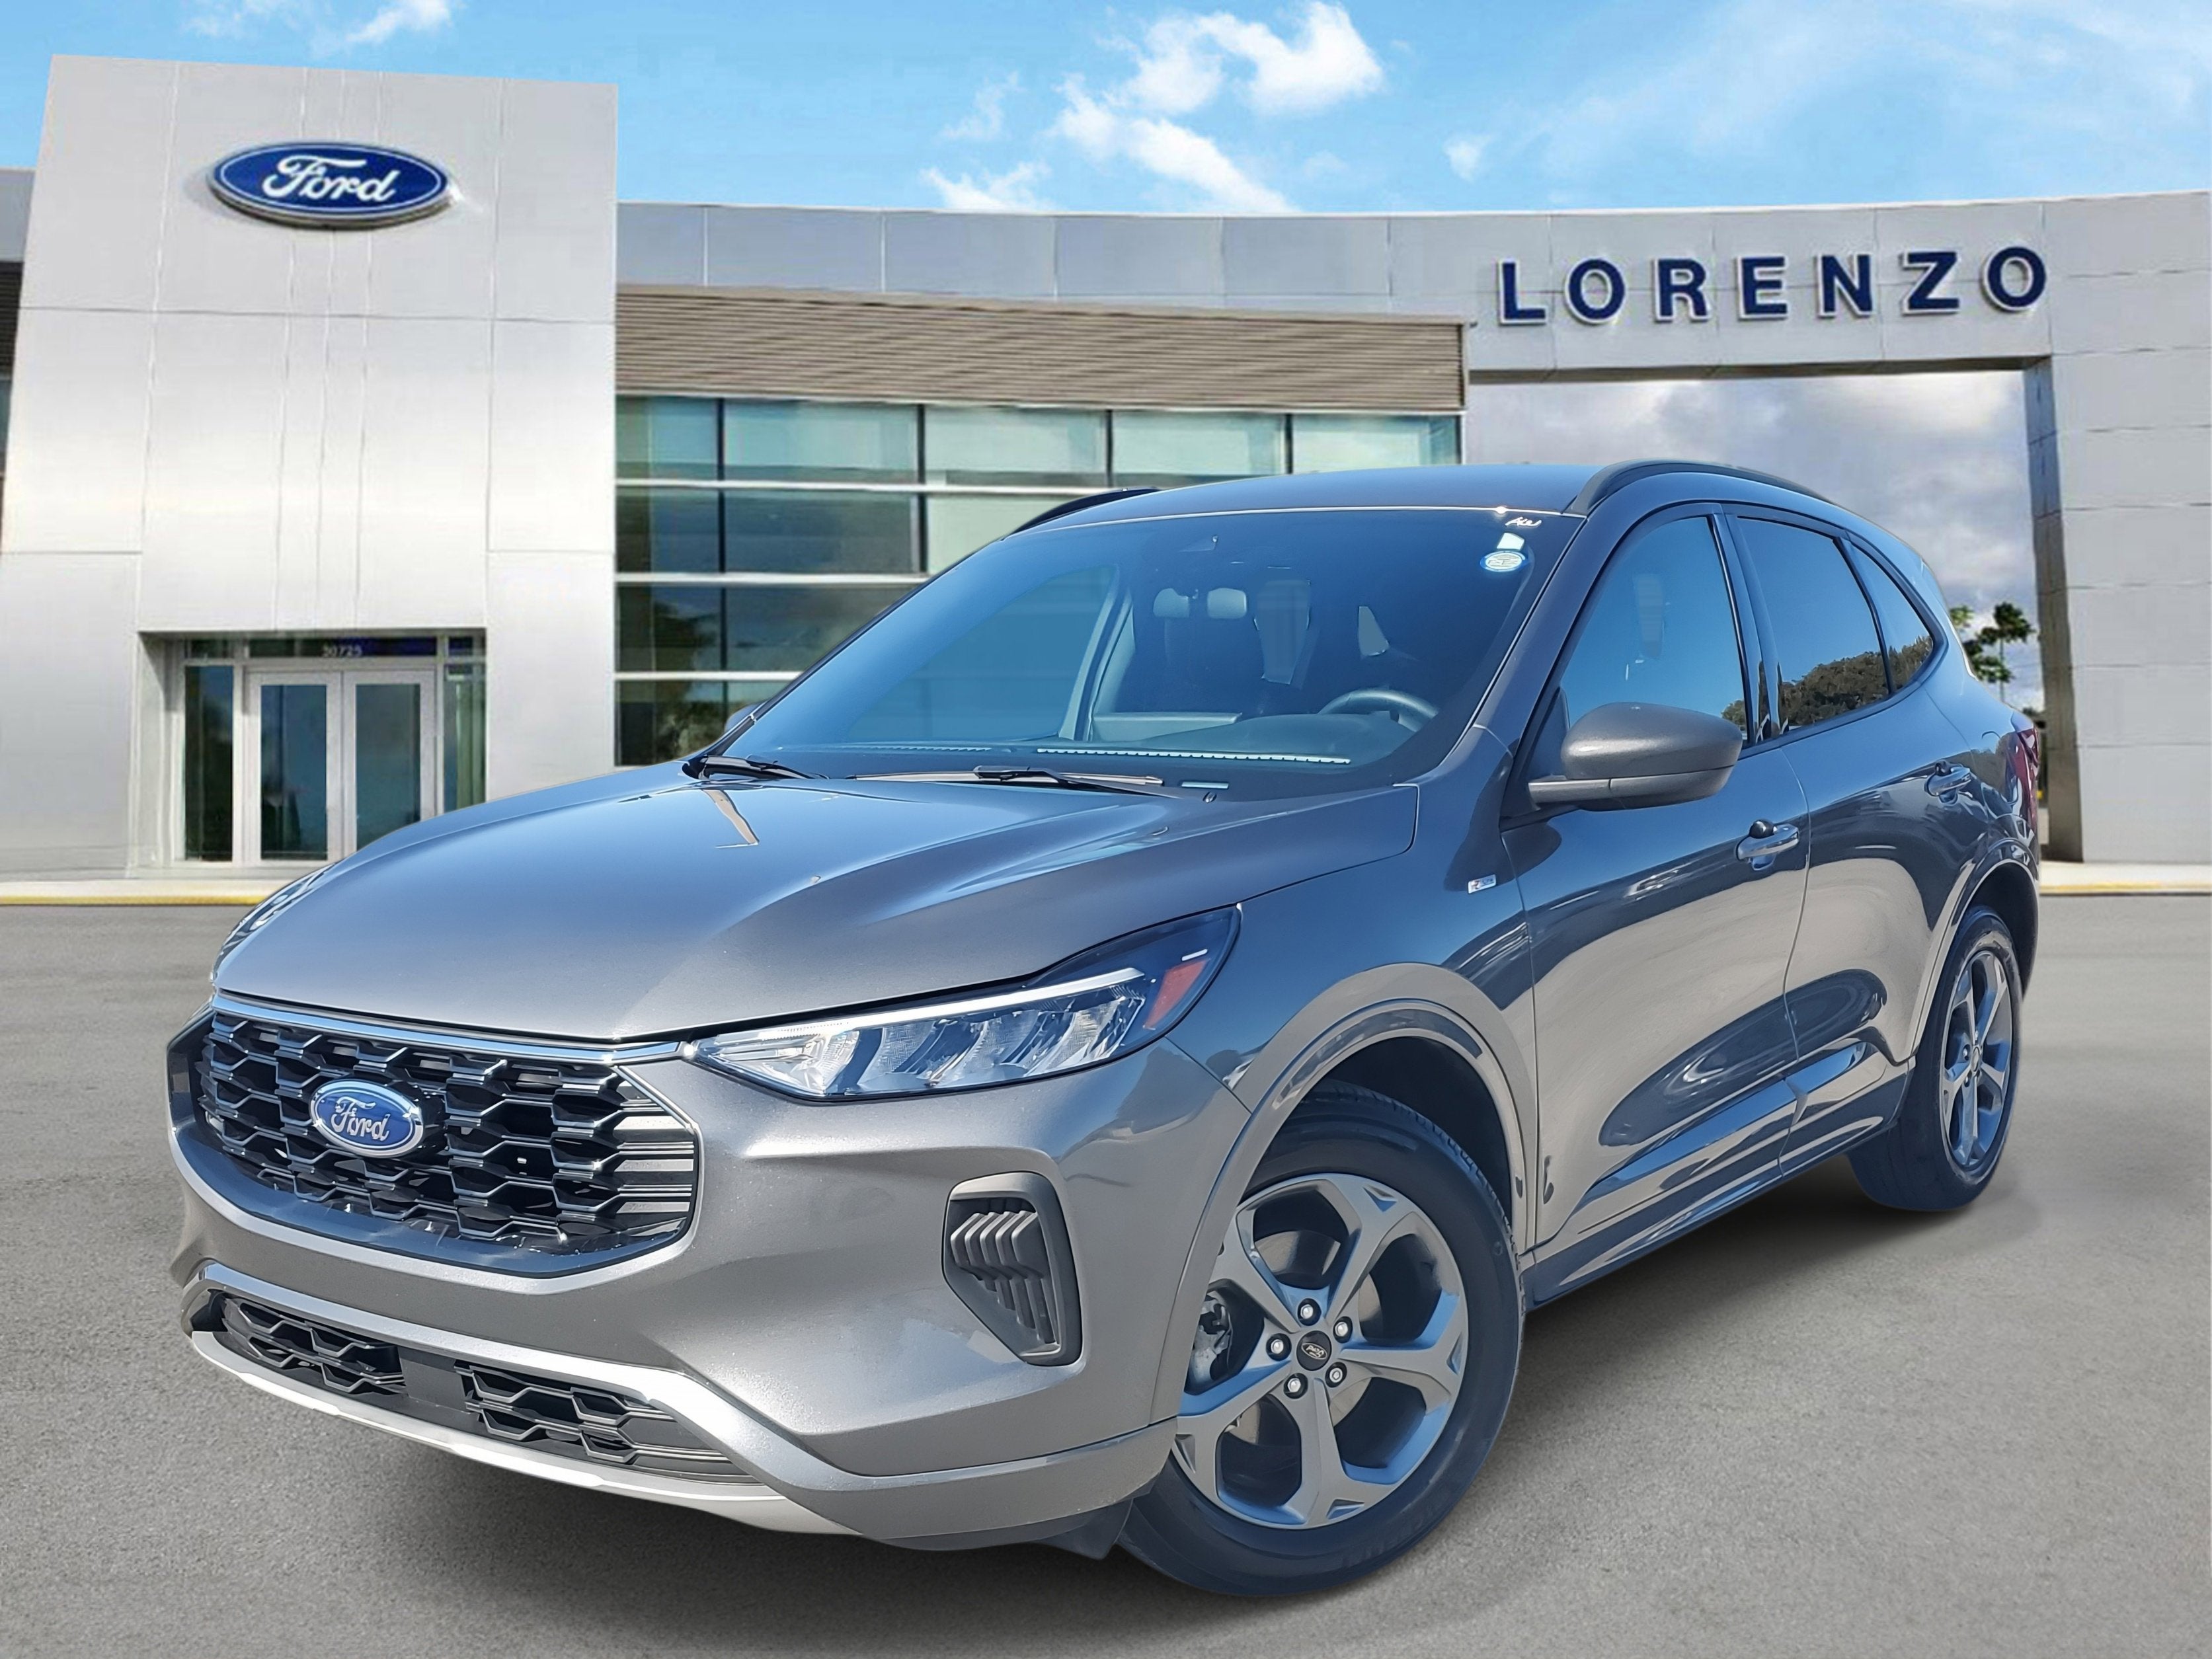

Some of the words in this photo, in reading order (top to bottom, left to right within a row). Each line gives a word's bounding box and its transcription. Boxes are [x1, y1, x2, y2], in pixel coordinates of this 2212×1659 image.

[261, 154, 400, 202] Ford
[1499, 246, 2047, 324] LORENZO
[331, 1095, 391, 1141] Ford
